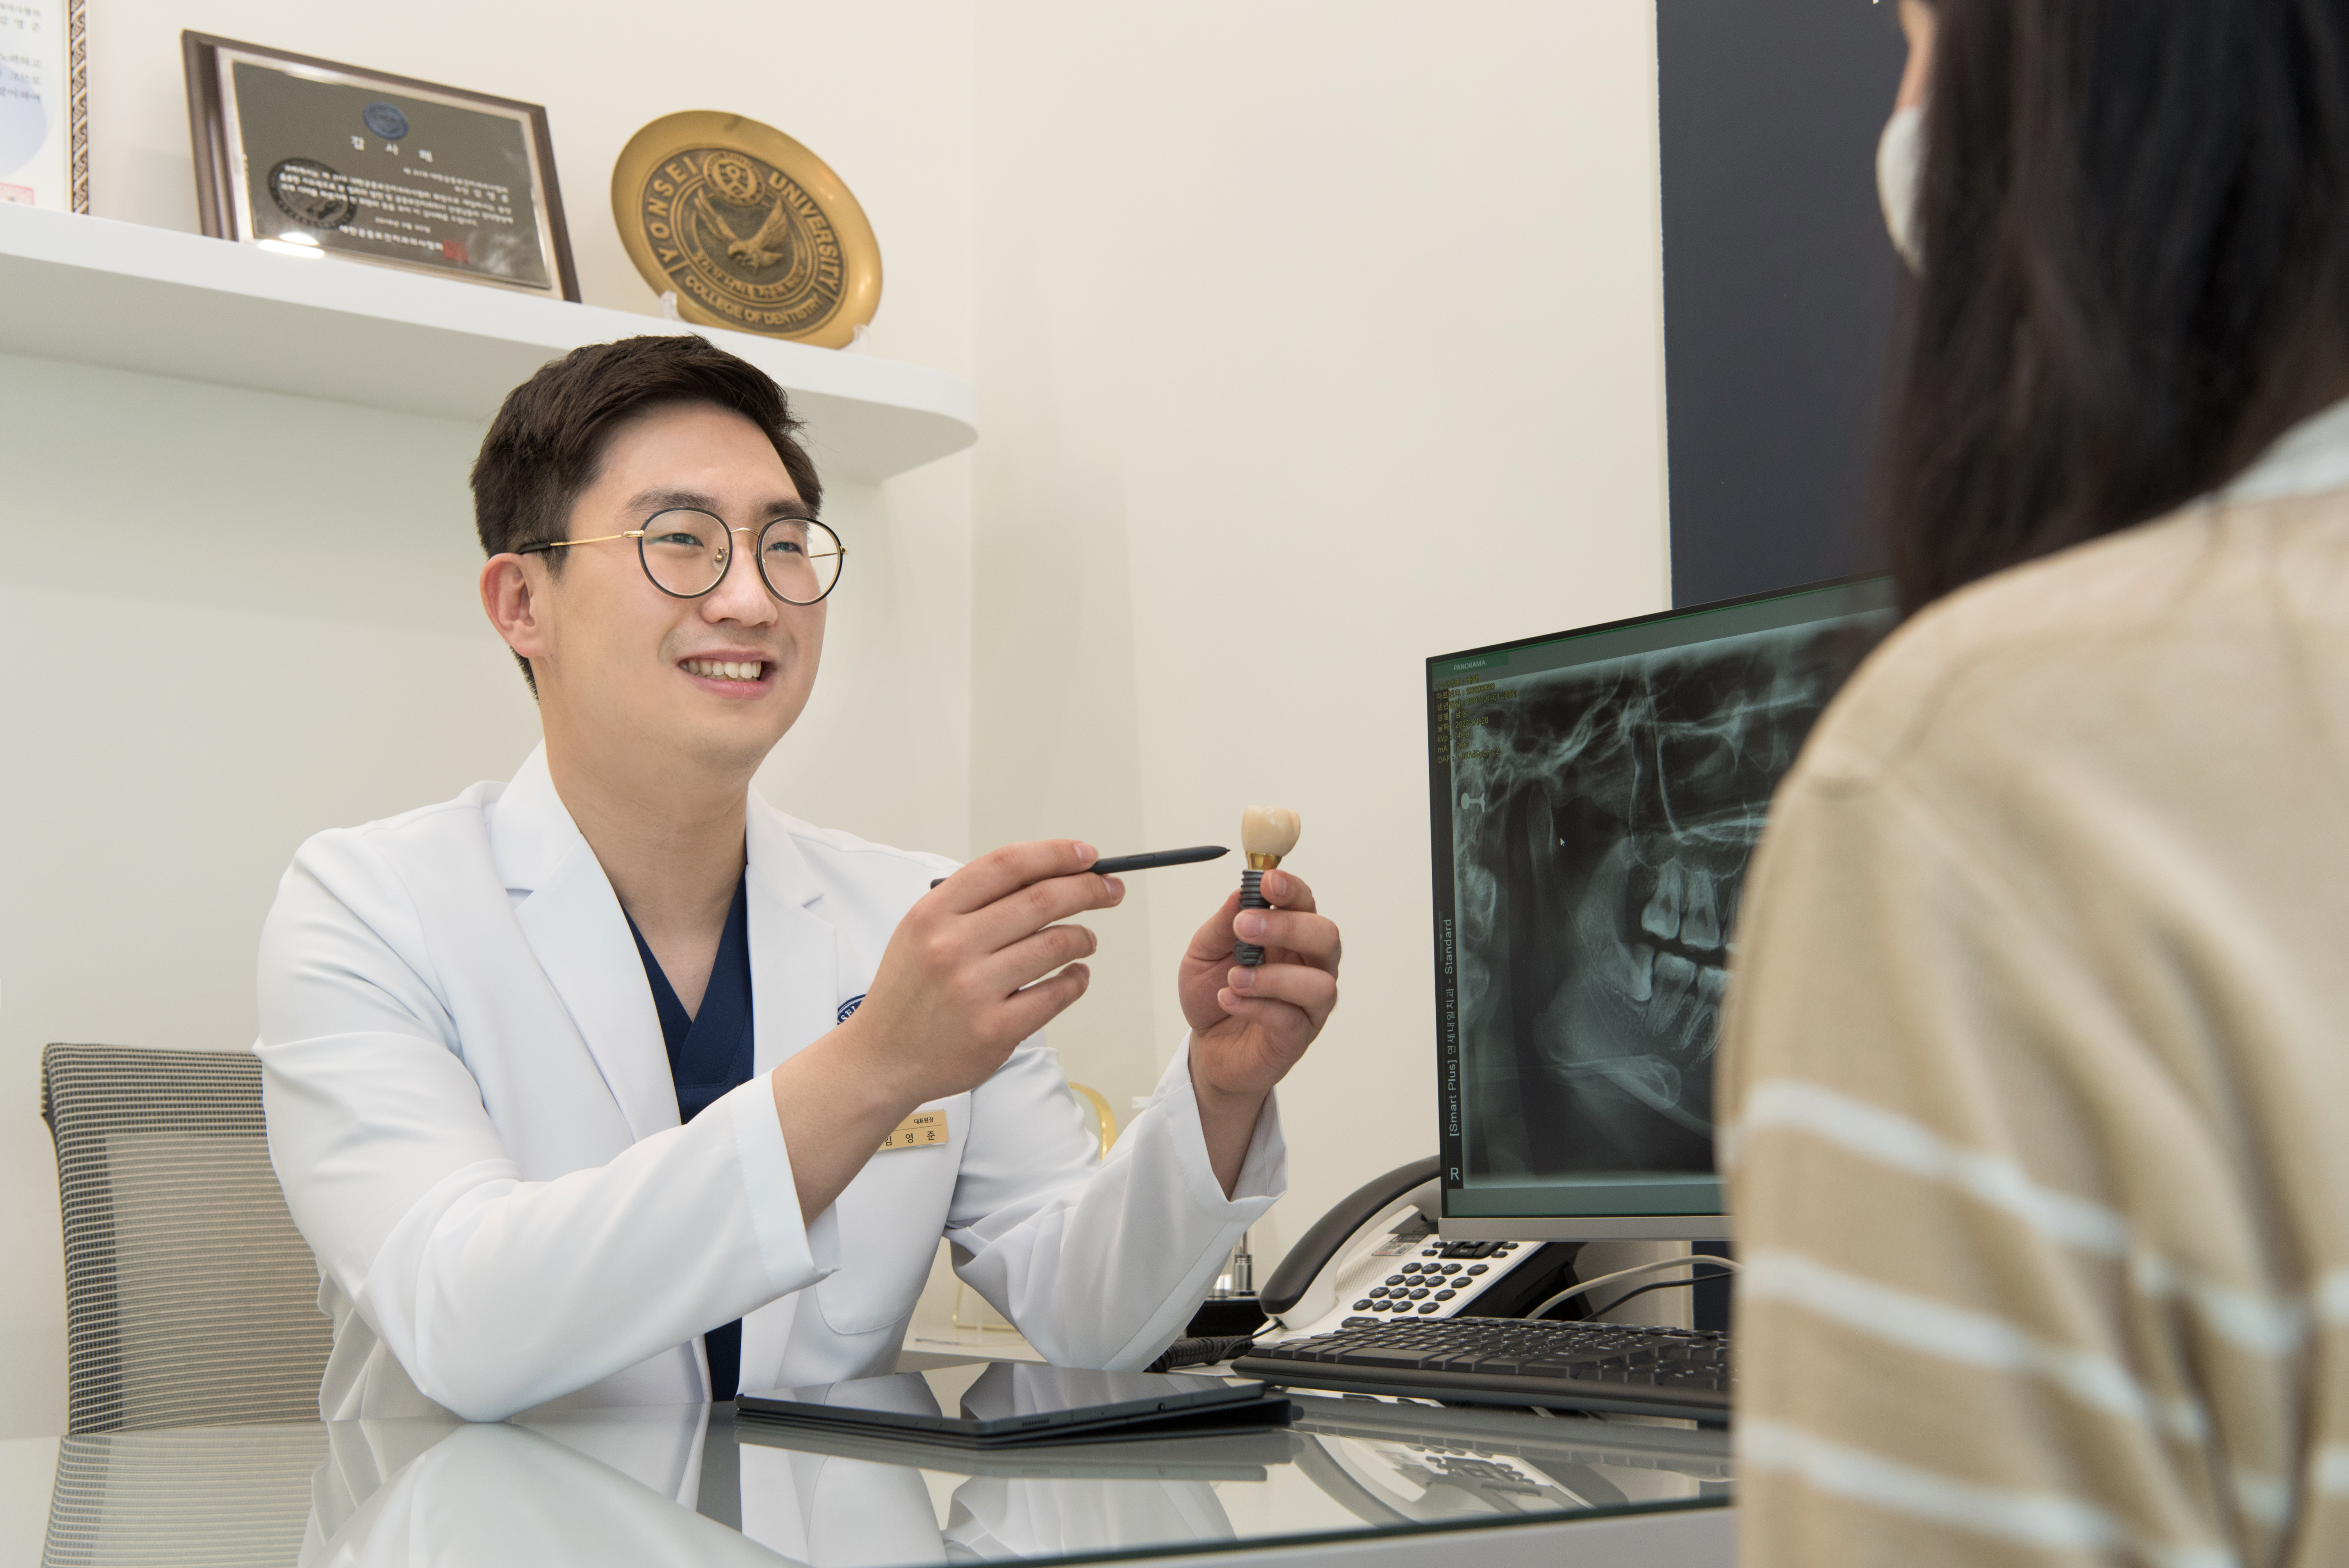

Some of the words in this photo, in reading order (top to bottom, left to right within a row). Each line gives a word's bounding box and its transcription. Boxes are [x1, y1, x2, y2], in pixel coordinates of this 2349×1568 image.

[648, 156, 699, 264] YONSEI
[768, 172, 841, 293] UNIVERSITY
[685, 275, 744, 321] COLLEGE
[744, 308, 763, 323] OF
[763, 293, 826, 326] DENTISTRY
[1454, 660, 1486, 671] PANORAMA
[1436, 689, 1461, 700] 차트번호
[1437, 699, 1461, 711] 생년월일
[1467, 693, 1499, 705] 1987-01-01
[1502, 690, 1517, 700] (35Y)
[1438, 713, 1449, 722] 성별
[1456, 709, 1467, 718] 남성
[1438, 723, 1449, 732] 날짜
[1455, 716, 1488, 729] 2022-04-28
[1438, 735, 1448, 743] kVp
[1454, 731, 1469, 739] 74.00
[1454, 741, 1469, 750] 12.00
[1438, 755, 1450, 764] DAP
[1443, 919, 1453, 975] Standard
[1446, 988, 1456, 1055] 연세내일치과
[1447, 1060, 1457, 1090] Plus]
[1449, 1095, 1460, 1136] [Smart
[1451, 1167, 1460, 1180] R
